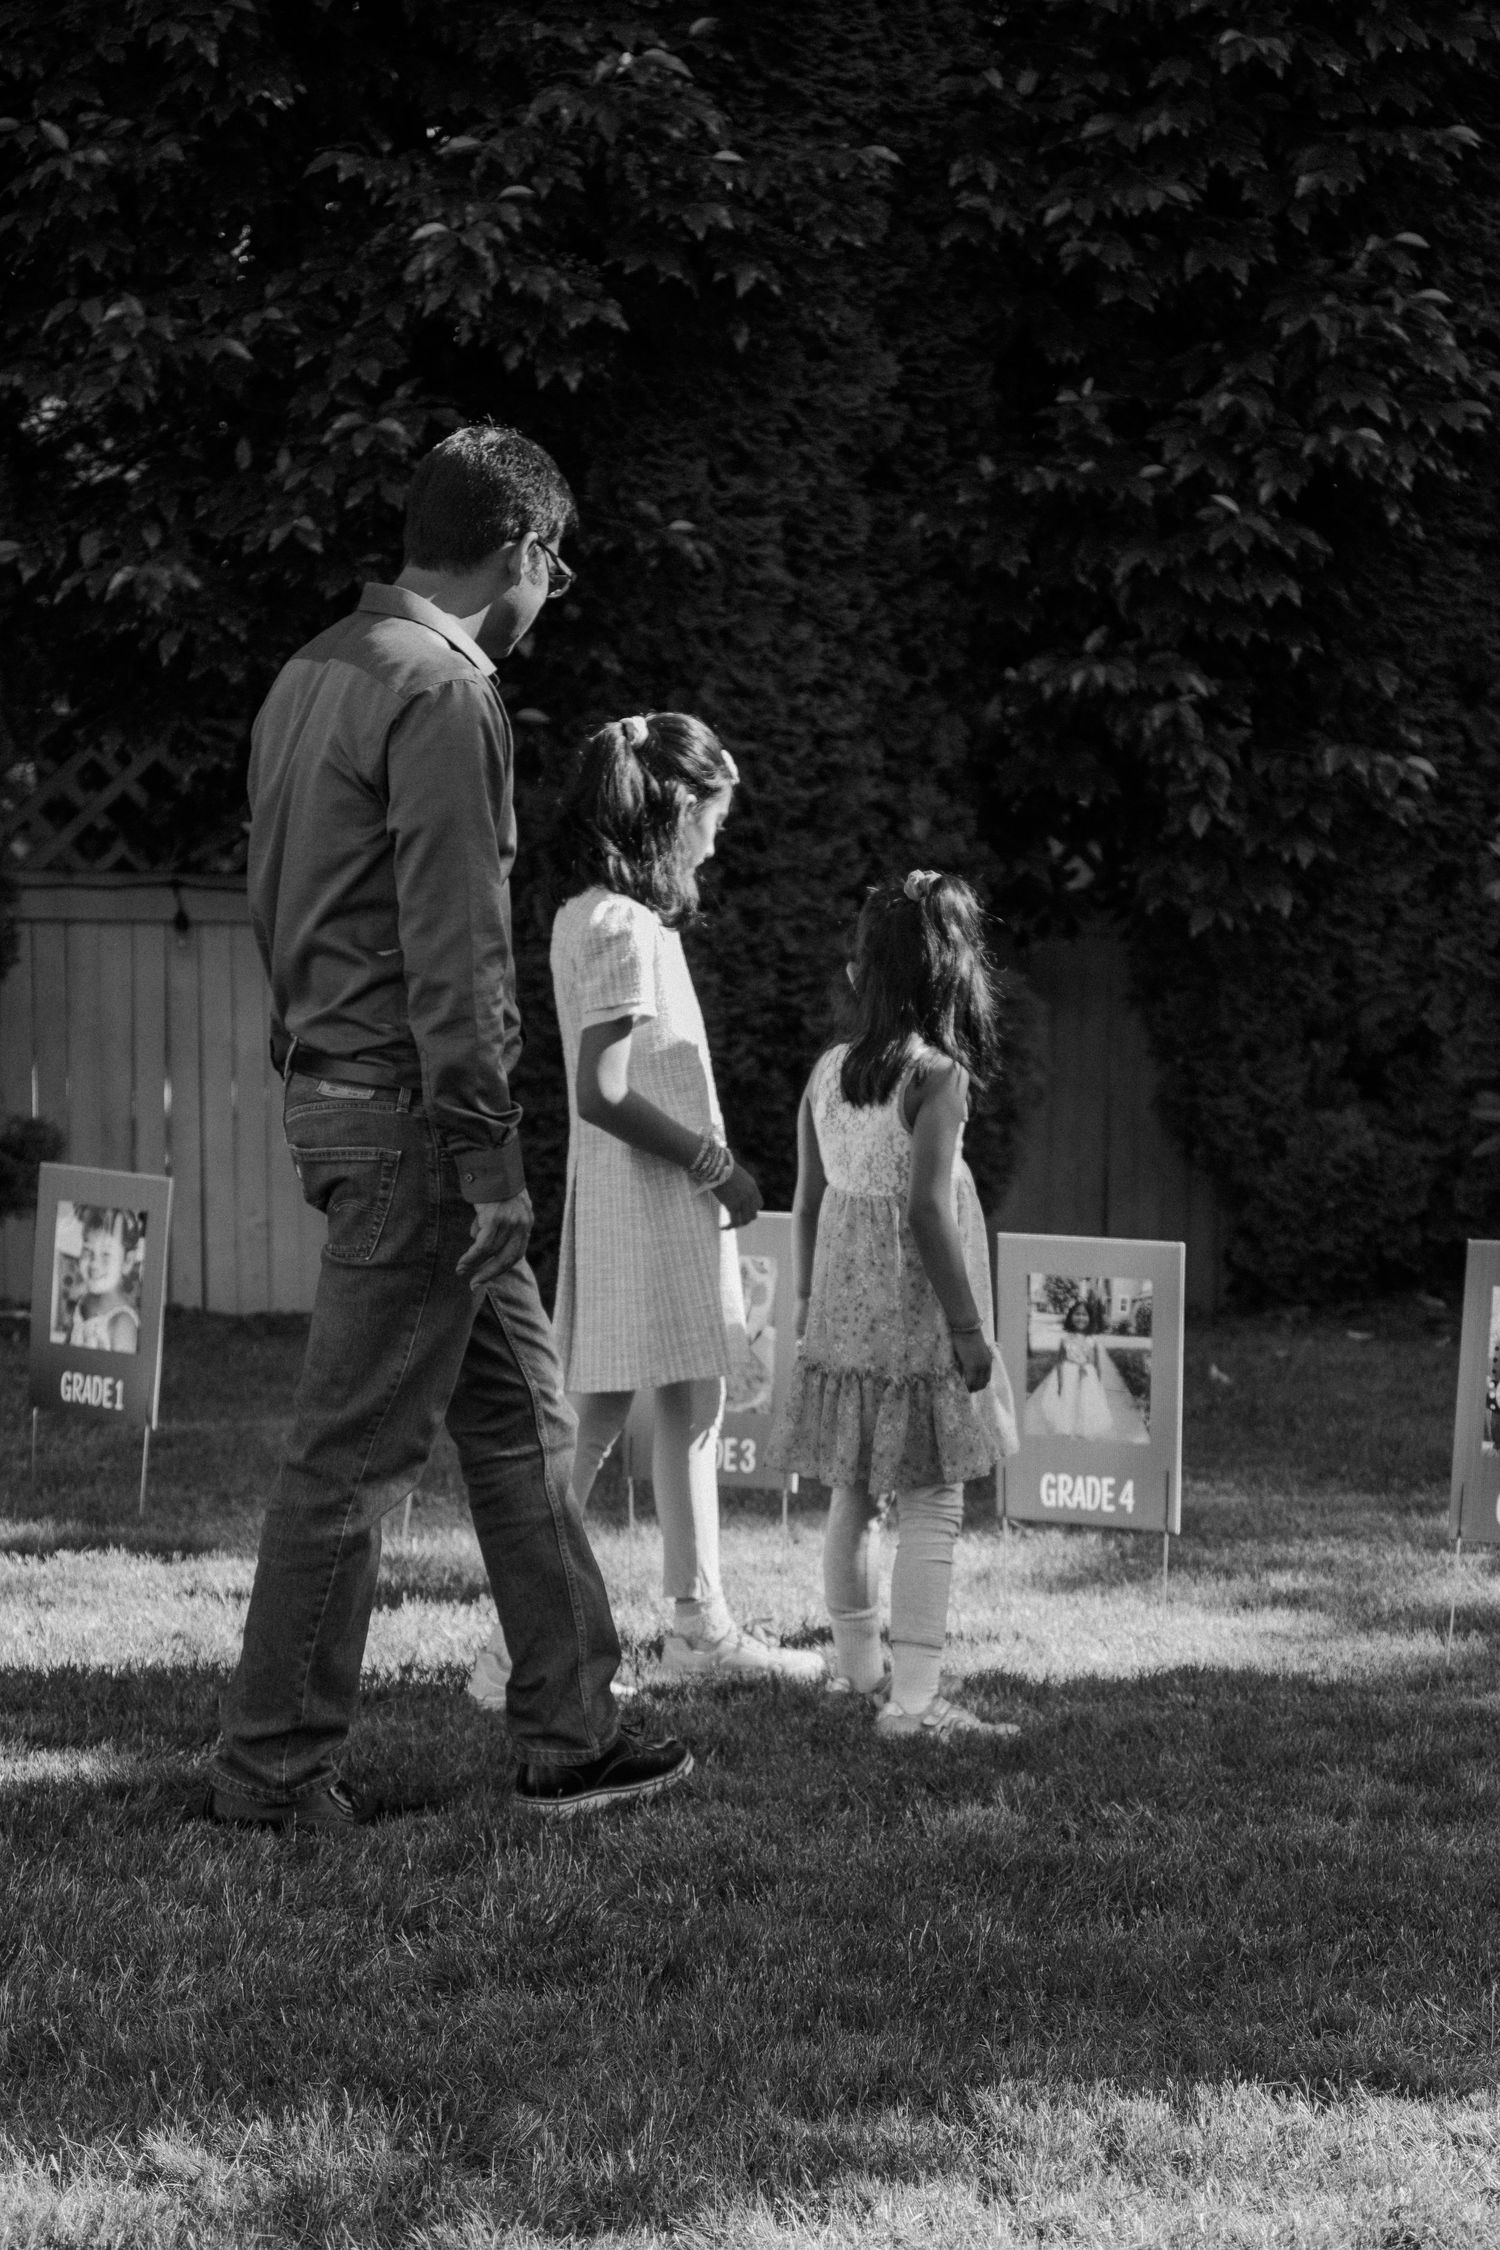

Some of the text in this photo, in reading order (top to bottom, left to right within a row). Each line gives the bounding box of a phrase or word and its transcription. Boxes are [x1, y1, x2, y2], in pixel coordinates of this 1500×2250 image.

[61, 1371, 124, 1411] GRADE 1
[740, 1438, 756, 1474] 3
[1040, 1472, 1135, 1514] GRADE 4
